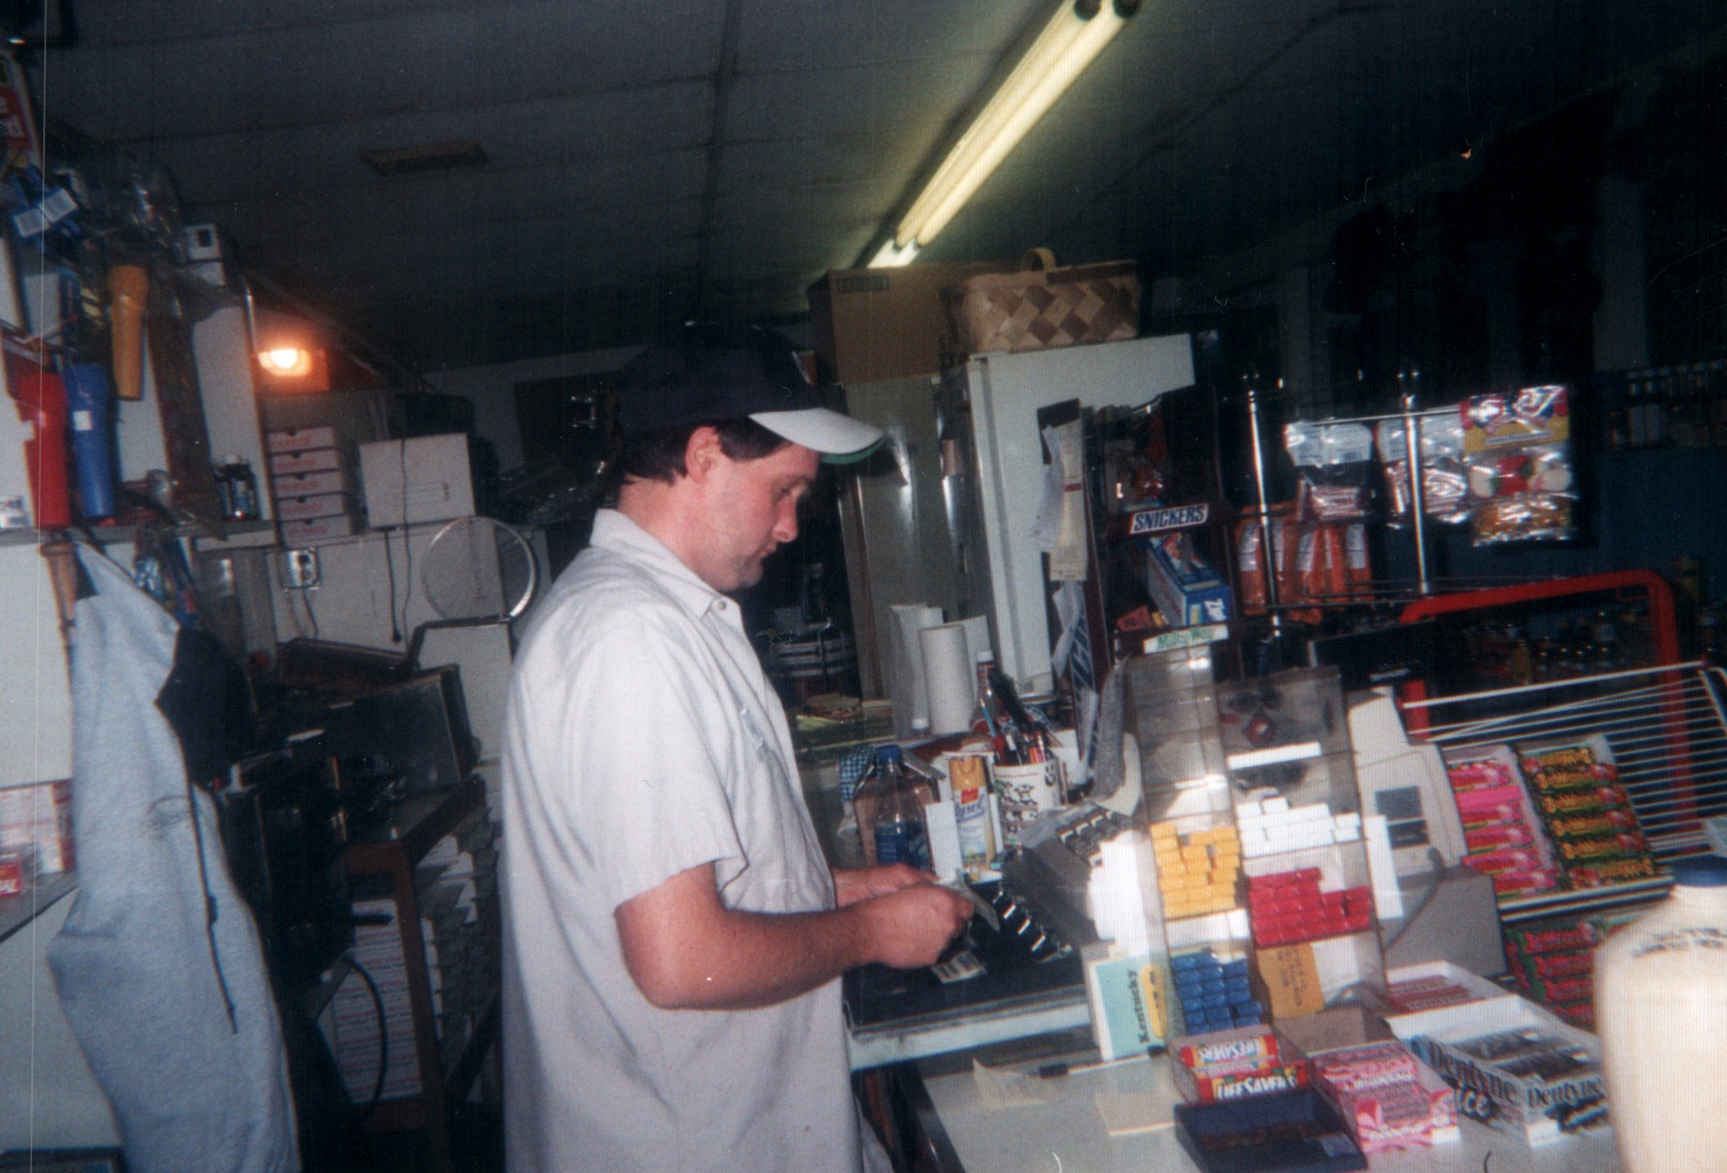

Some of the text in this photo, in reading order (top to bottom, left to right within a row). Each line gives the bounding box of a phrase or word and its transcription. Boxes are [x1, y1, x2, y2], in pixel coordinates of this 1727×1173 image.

[1135, 504, 1205, 531] SNICKERS
[1127, 969, 1150, 1044] Kentucky
[1429, 1040, 1517, 1105] Dentyne
[1527, 1079, 1602, 1109] Dentyne
